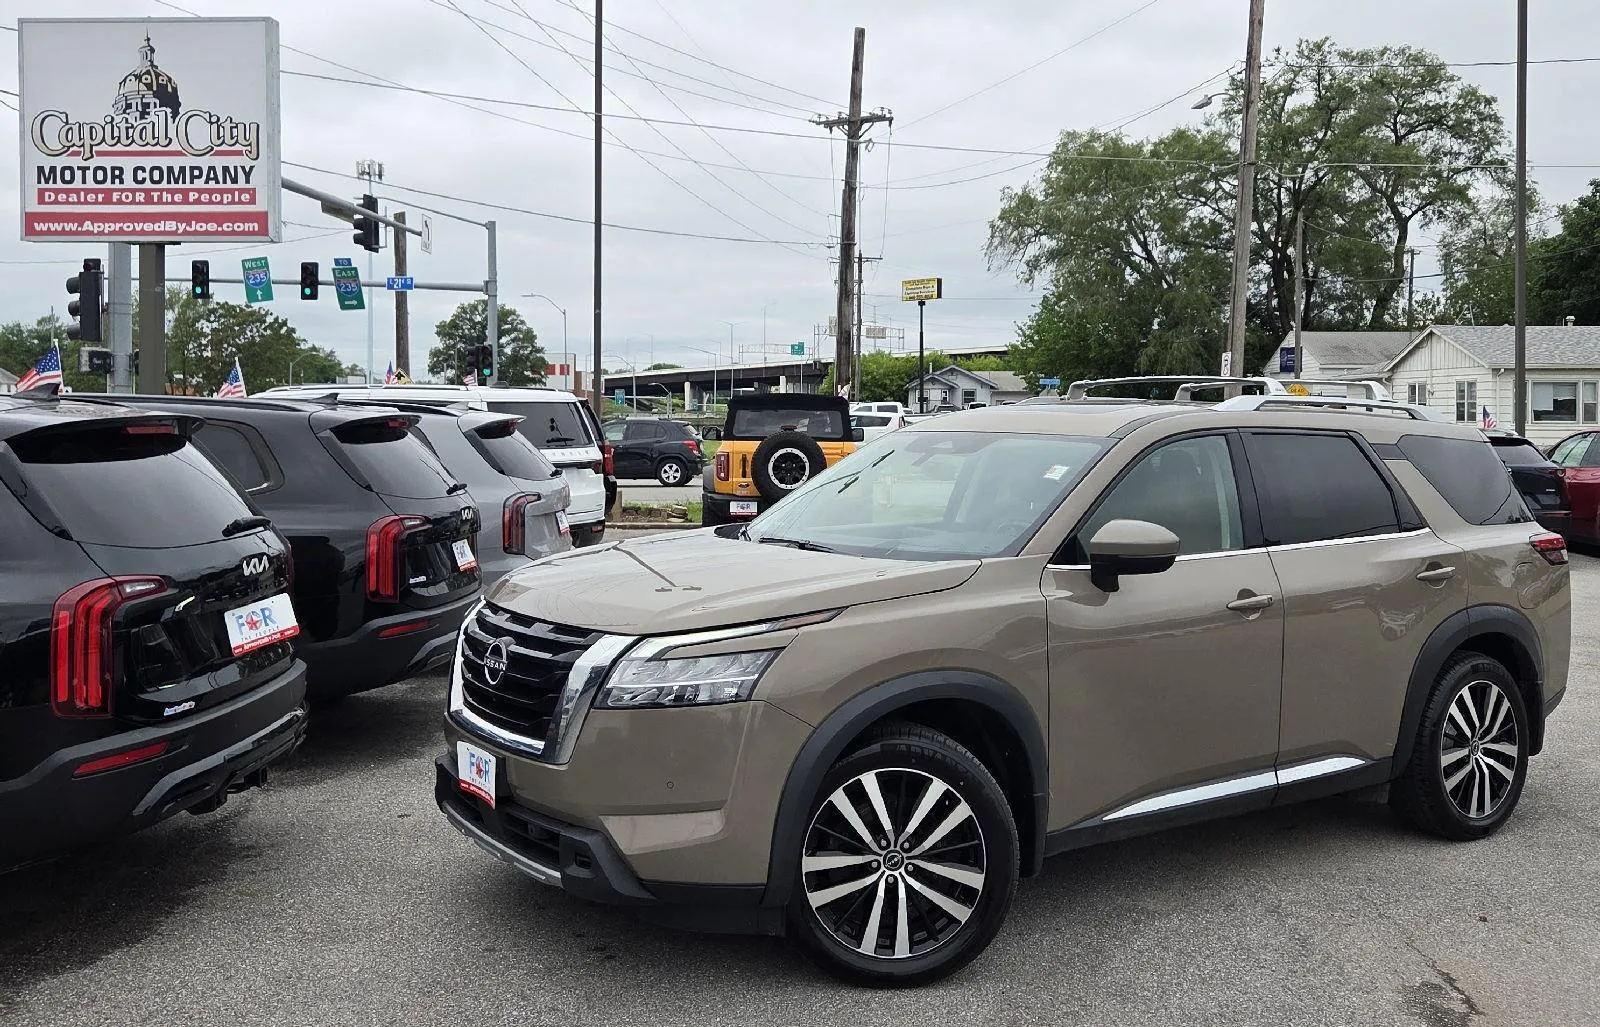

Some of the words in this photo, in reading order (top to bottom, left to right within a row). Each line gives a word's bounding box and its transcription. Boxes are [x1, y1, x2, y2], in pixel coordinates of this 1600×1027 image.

[31, 109, 171, 161] Capital
[176, 109, 260, 161] City
[37, 165, 125, 185] MOTOR
[132, 164, 256, 185] COMPANY
[44, 191, 105, 203] Dealer
[112, 190, 145, 203] FOR
[151, 190, 183, 203] The
[188, 190, 251, 205] People
[34, 219, 259, 234] www.ApprovedByJoe.com
[248, 273, 267, 284] 235
[335, 269, 356, 277] EAST
[340, 282, 358, 292] 235
[242, 554, 270, 577] KIA
[235, 606, 278, 636] FOR
